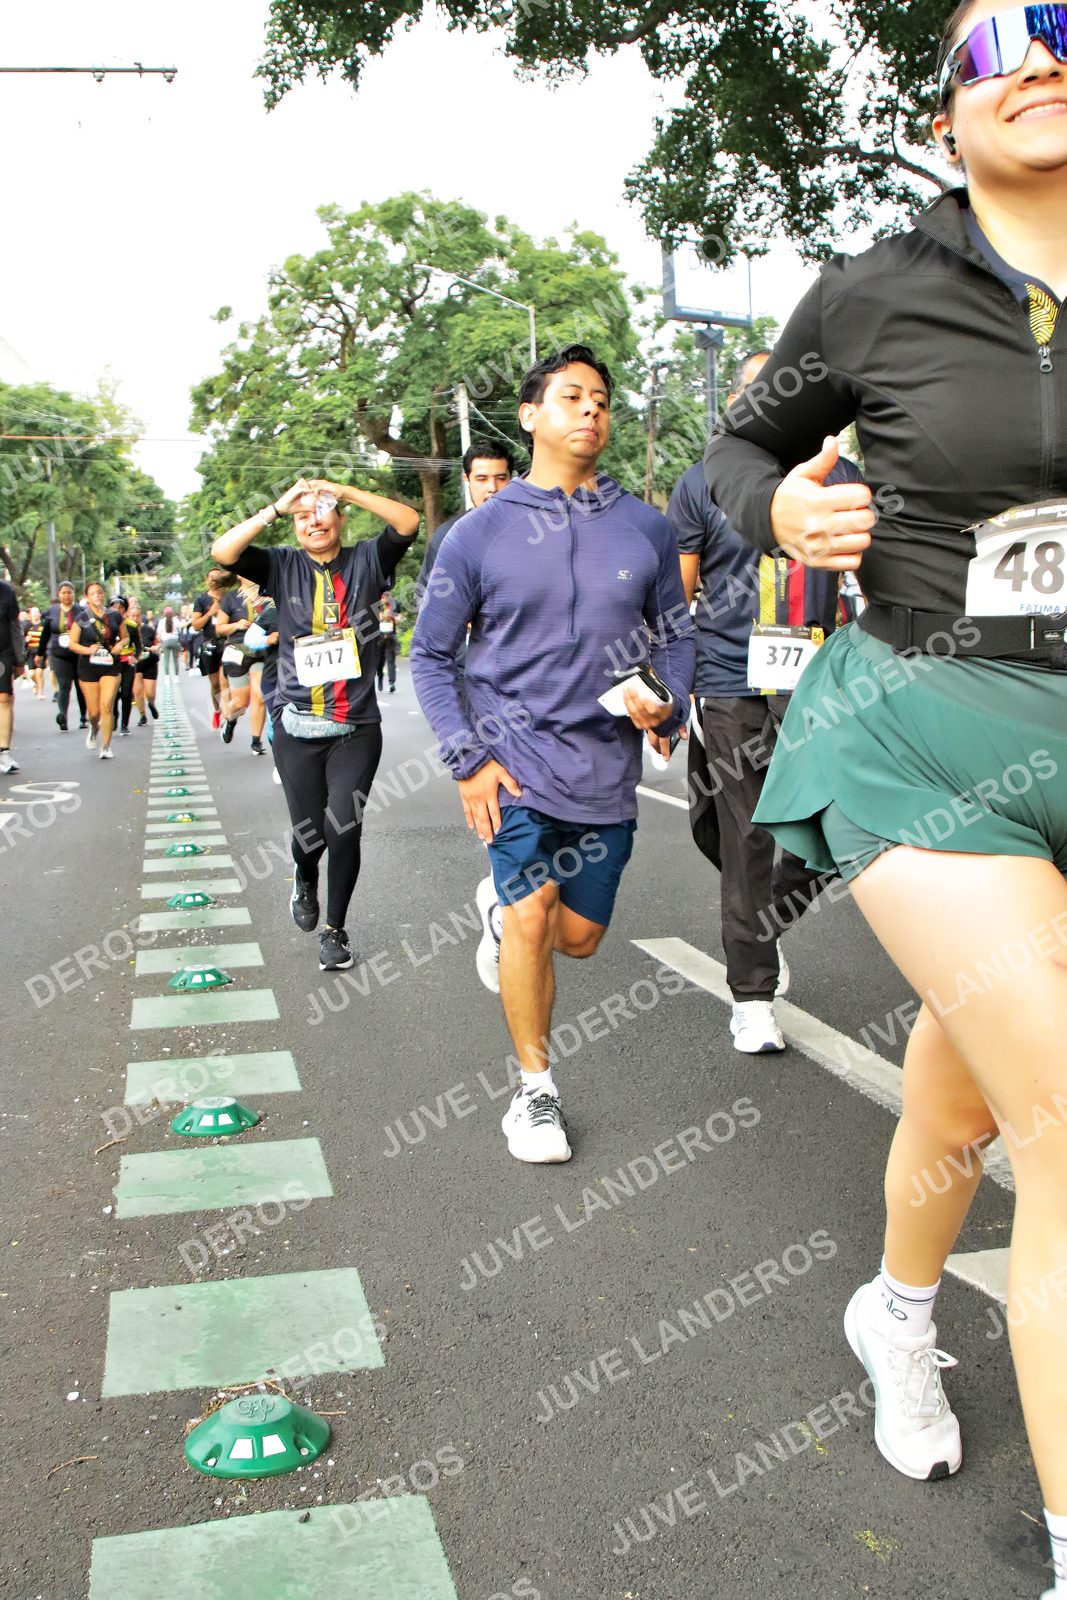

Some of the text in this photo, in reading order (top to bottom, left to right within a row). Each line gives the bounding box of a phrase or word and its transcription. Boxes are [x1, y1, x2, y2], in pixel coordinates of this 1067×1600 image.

[1019, 604, 1061, 613] FATIMA
[304, 647, 343, 668] 4717
[766, 645, 804, 667] 377
